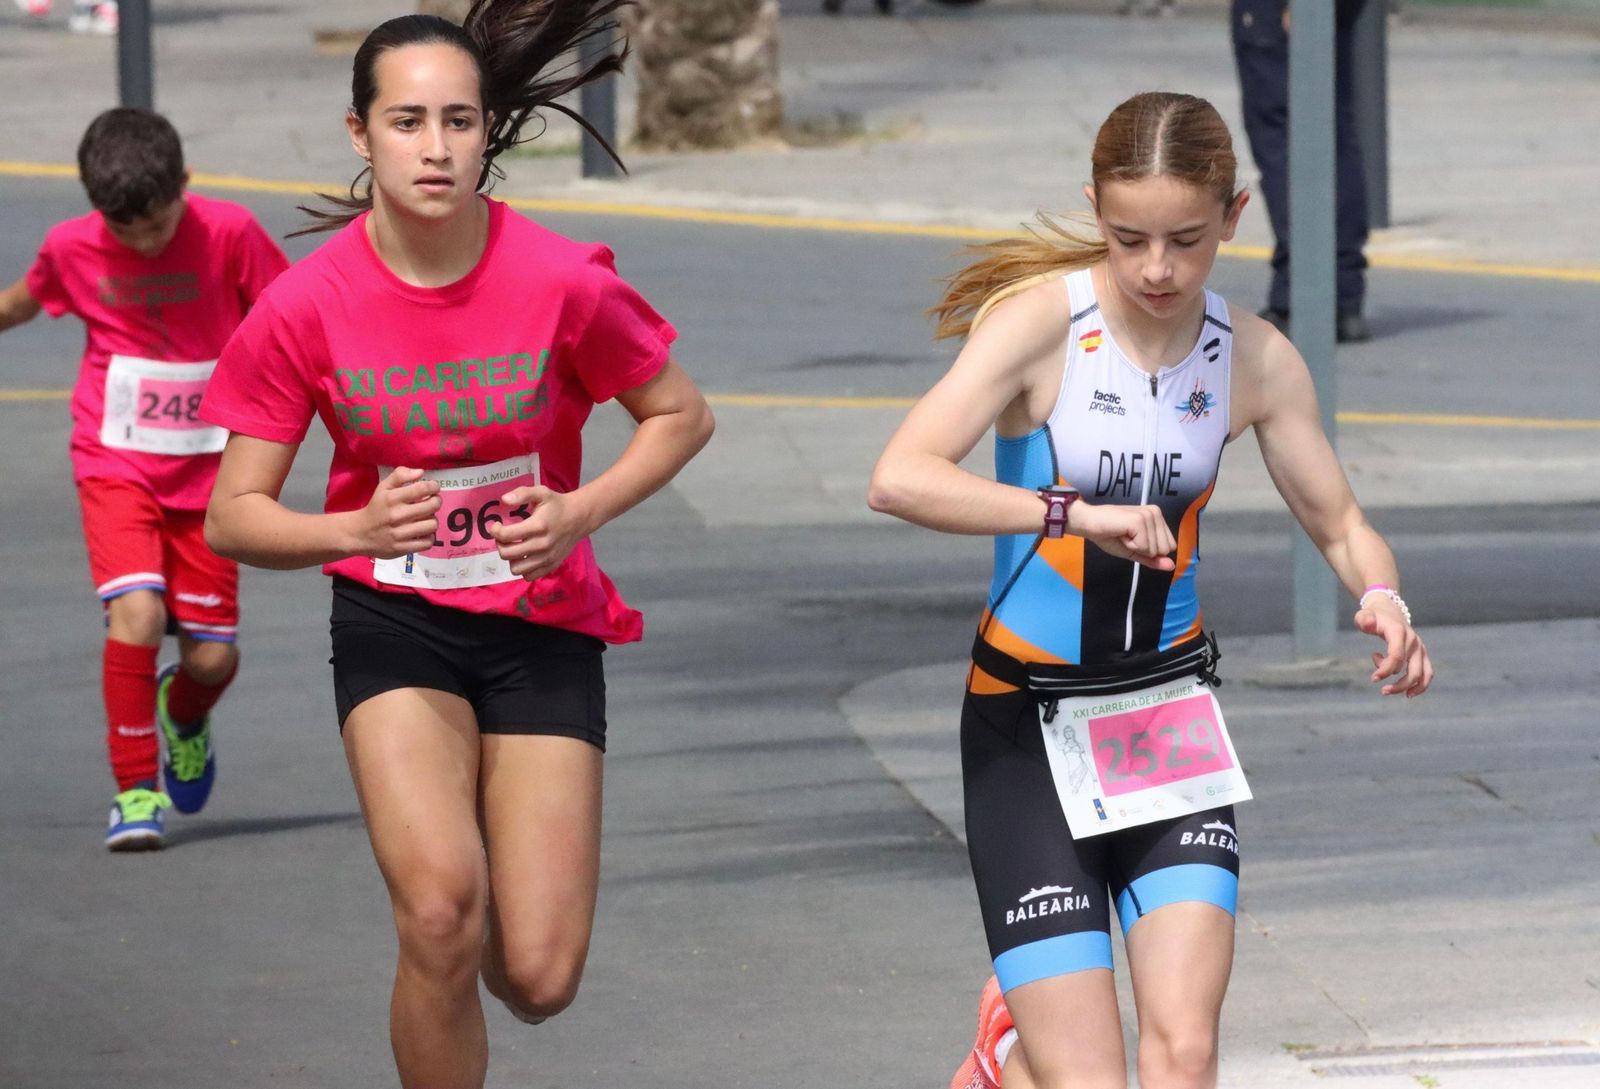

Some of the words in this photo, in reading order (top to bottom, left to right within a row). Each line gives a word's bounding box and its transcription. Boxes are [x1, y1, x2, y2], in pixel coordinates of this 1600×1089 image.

[383, 348, 550, 397] CARRERA
[335, 402, 374, 435] DE
[437, 382, 549, 430] MUJER
[1089, 401, 1127, 417] projects
[1093, 389, 1121, 405] tactic
[462, 478, 475, 487] DE
[477, 476, 488, 485] LA
[490, 467, 520, 481] MUJER
[1072, 708, 1089, 720] XXI
[1091, 699, 1138, 716] CARRERA
[1139, 695, 1151, 706] DE
[1152, 693, 1163, 703] LA
[1164, 685, 1194, 700] MUJER
[1099, 718, 1218, 784] 2529
